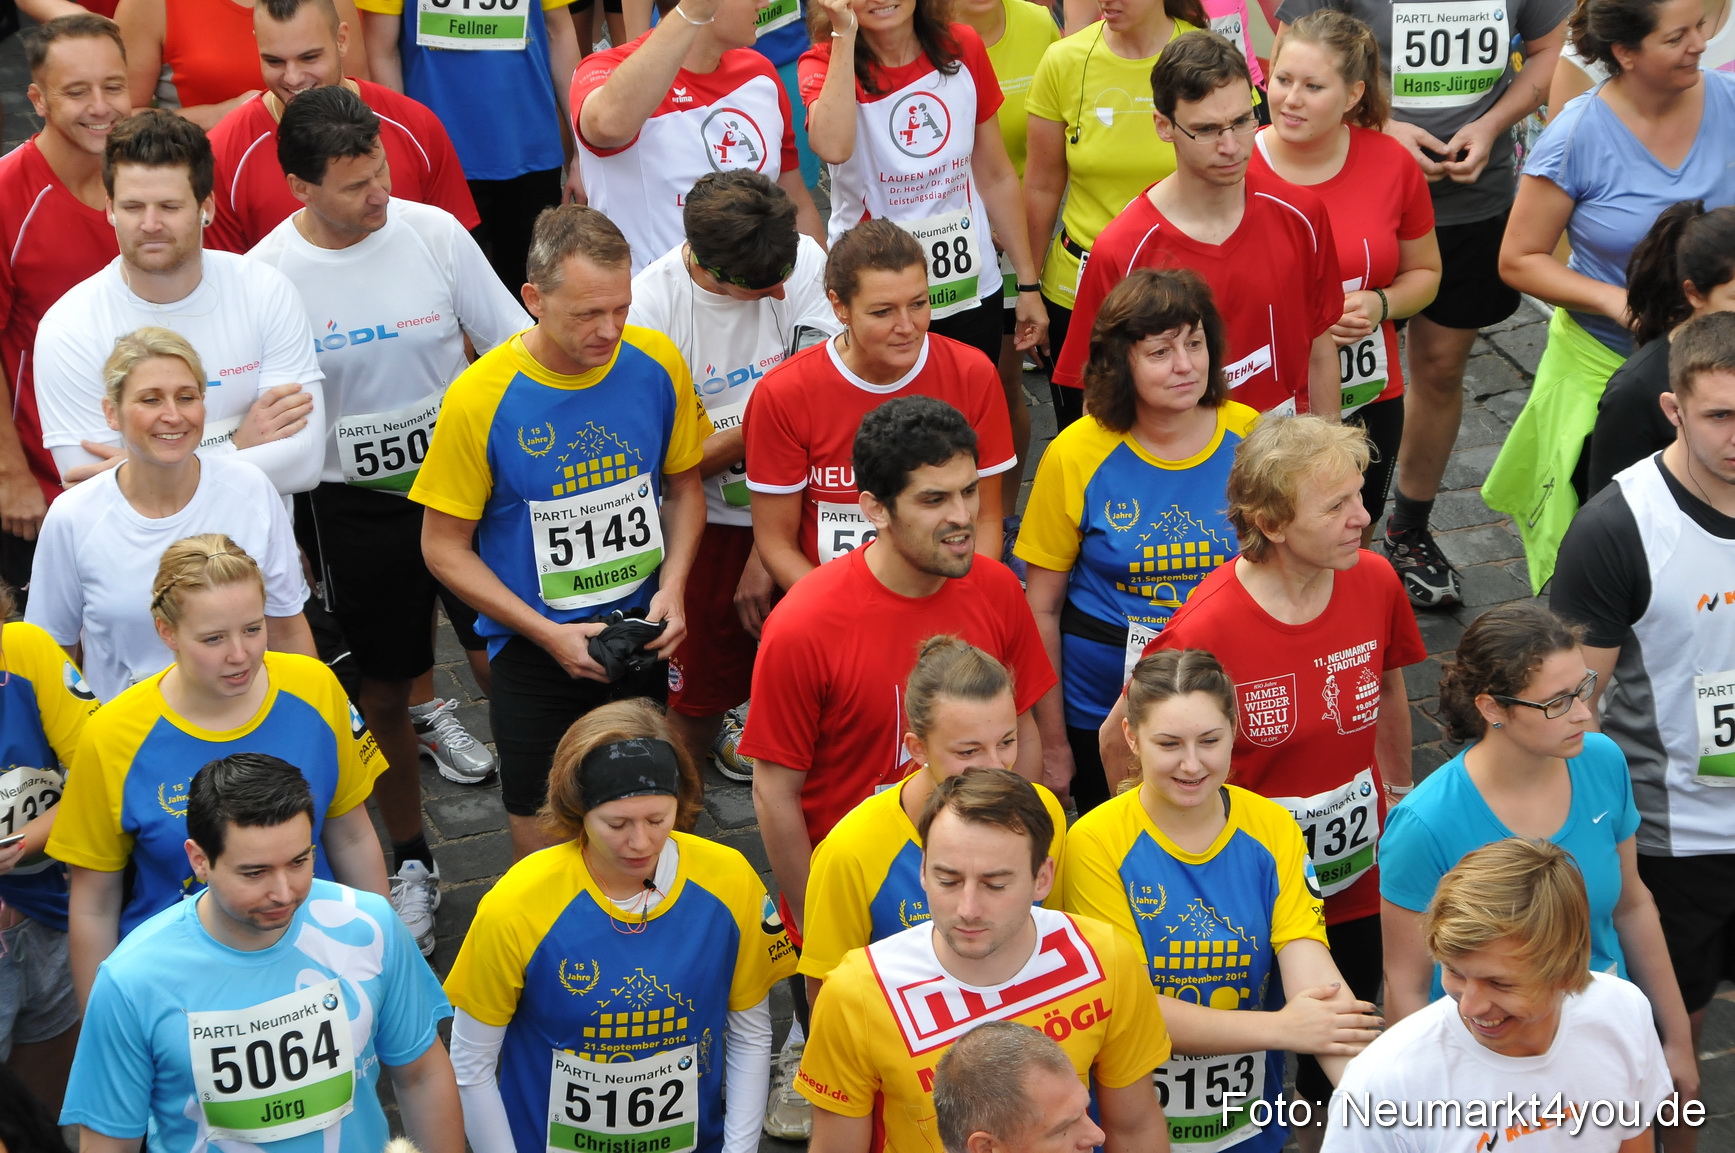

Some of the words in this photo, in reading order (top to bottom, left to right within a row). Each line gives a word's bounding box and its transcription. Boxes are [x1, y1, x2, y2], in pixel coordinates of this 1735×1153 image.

[753, 5, 782, 25] arina
[1396, 14, 1434, 23] PARTL
[1437, 12, 1490, 22] Neumarkt
[449, 19, 498, 35] Fellner
[1405, 26, 1499, 67] 5019
[1403, 76, 1494, 93] Hans-Jürgen
[912, 222, 958, 240] Neumarkt
[397, 310, 441, 329] energie
[1227, 360, 1255, 382] DEHN
[339, 425, 381, 438] PARTL
[383, 405, 437, 432] Neumarkt
[531, 427, 541, 435] 15
[353, 420, 438, 477] 550
[526, 436, 549, 446] Jahre
[534, 509, 578, 522] PARTL
[580, 492, 635, 516] Neumarkt
[1117, 502, 1127, 510] 15
[821, 511, 865, 523] PARTL
[1112, 512, 1133, 520] Jahre
[548, 506, 651, 566] 5143
[573, 564, 638, 591] Andreas
[1313, 658, 1327, 668] 11.
[1327, 652, 1372, 675] STADTLAUF
[1245, 685, 1287, 702] IMMER
[1698, 683, 1735, 699] PART
[1244, 696, 1290, 712] WIEDER
[1248, 708, 1288, 727] NEU
[1249, 723, 1289, 737] MARKT
[1, 776, 54, 801] Neumarkt
[172, 783, 183, 791] 15
[1306, 791, 1357, 819] Neumarkt
[912, 902, 923, 910] 15
[1136, 896, 1158, 905] Jahre
[908, 913, 931, 921] Jahre
[567, 973, 591, 981] Jahre
[1154, 974, 1223, 986] 21.September
[1225, 971, 1248, 981] 2014
[193, 1025, 247, 1040] PARTL
[250, 1003, 319, 1034] Neumarkt
[1034, 997, 1113, 1043] ÖGL
[583, 1038, 660, 1052] 21.September
[662, 1034, 687, 1045] 2014
[210, 1019, 340, 1095] 5064
[555, 1059, 601, 1084] PARTL
[605, 1062, 674, 1084] Neumarkt
[260, 1099, 305, 1123] Jörg
[564, 1079, 685, 1129] 5162
[574, 1131, 672, 1153] Christiane
